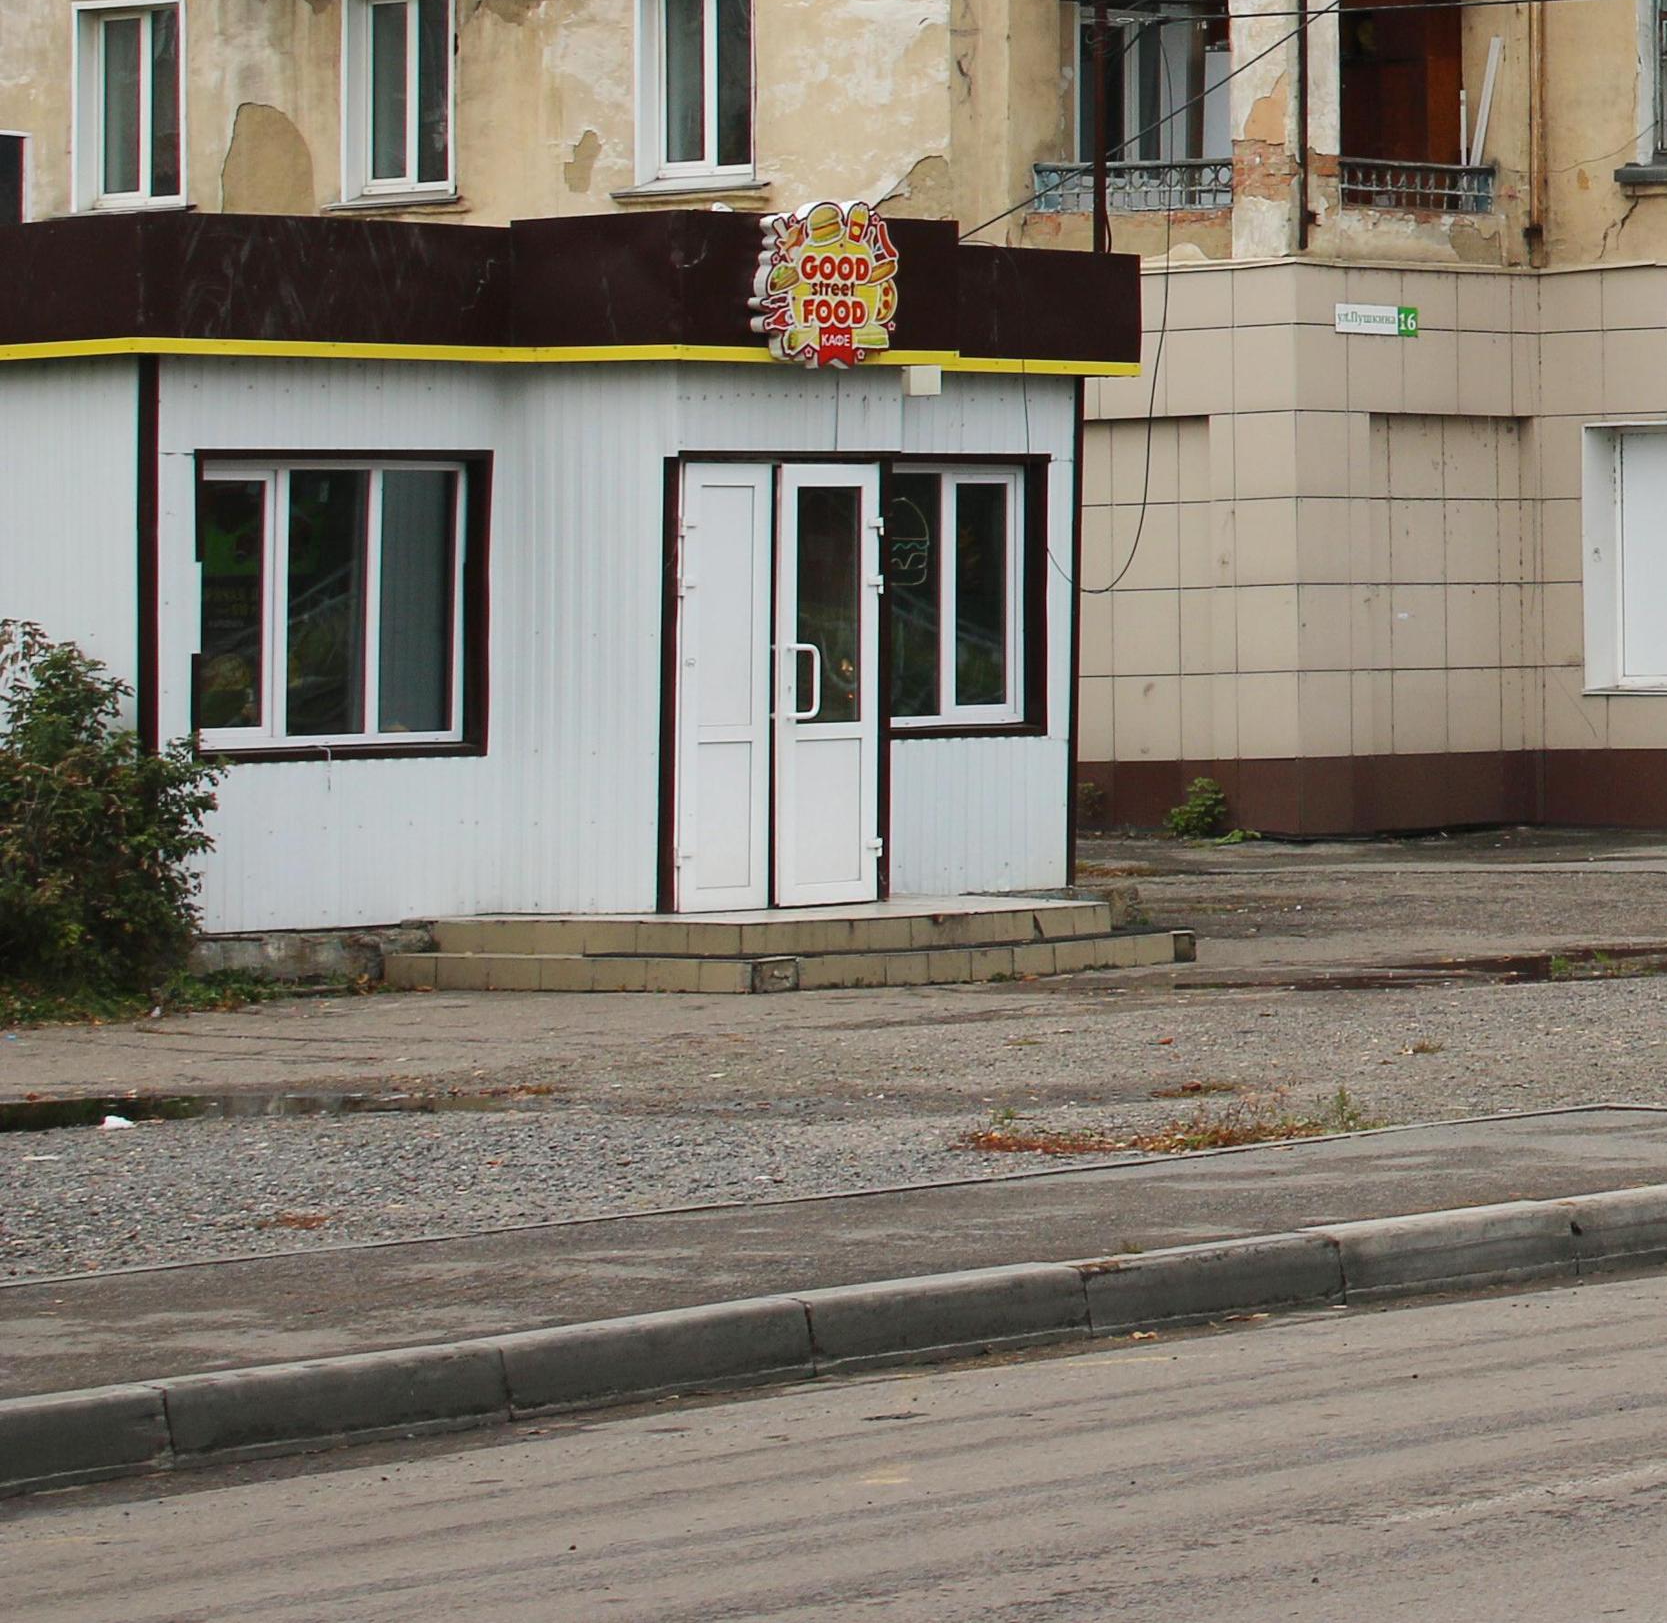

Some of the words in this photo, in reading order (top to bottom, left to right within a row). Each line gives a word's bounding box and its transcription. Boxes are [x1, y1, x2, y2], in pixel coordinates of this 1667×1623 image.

[800, 254, 870, 282] GOOD
[811, 281, 856, 297] street
[802, 298, 867, 326] FOOD
[1398, 313, 1417, 330] 16
[821, 334, 851, 347] КАФЕ
